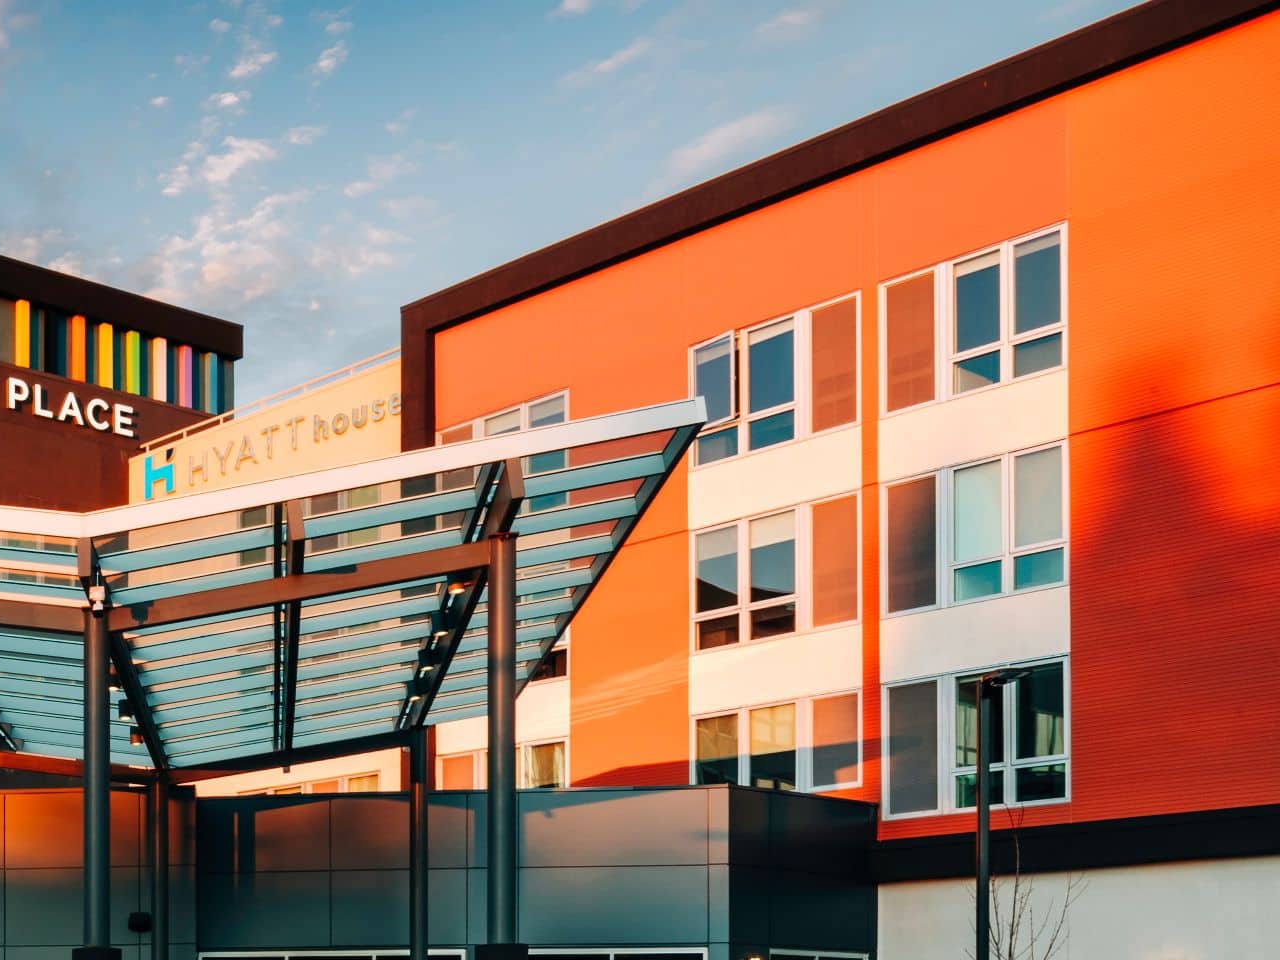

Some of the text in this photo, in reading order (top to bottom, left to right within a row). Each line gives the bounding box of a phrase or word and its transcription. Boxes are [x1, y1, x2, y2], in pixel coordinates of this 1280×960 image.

[7, 376, 135, 438] PLACE
[187, 416, 306, 487] HYATT
[312, 393, 402, 443] house
